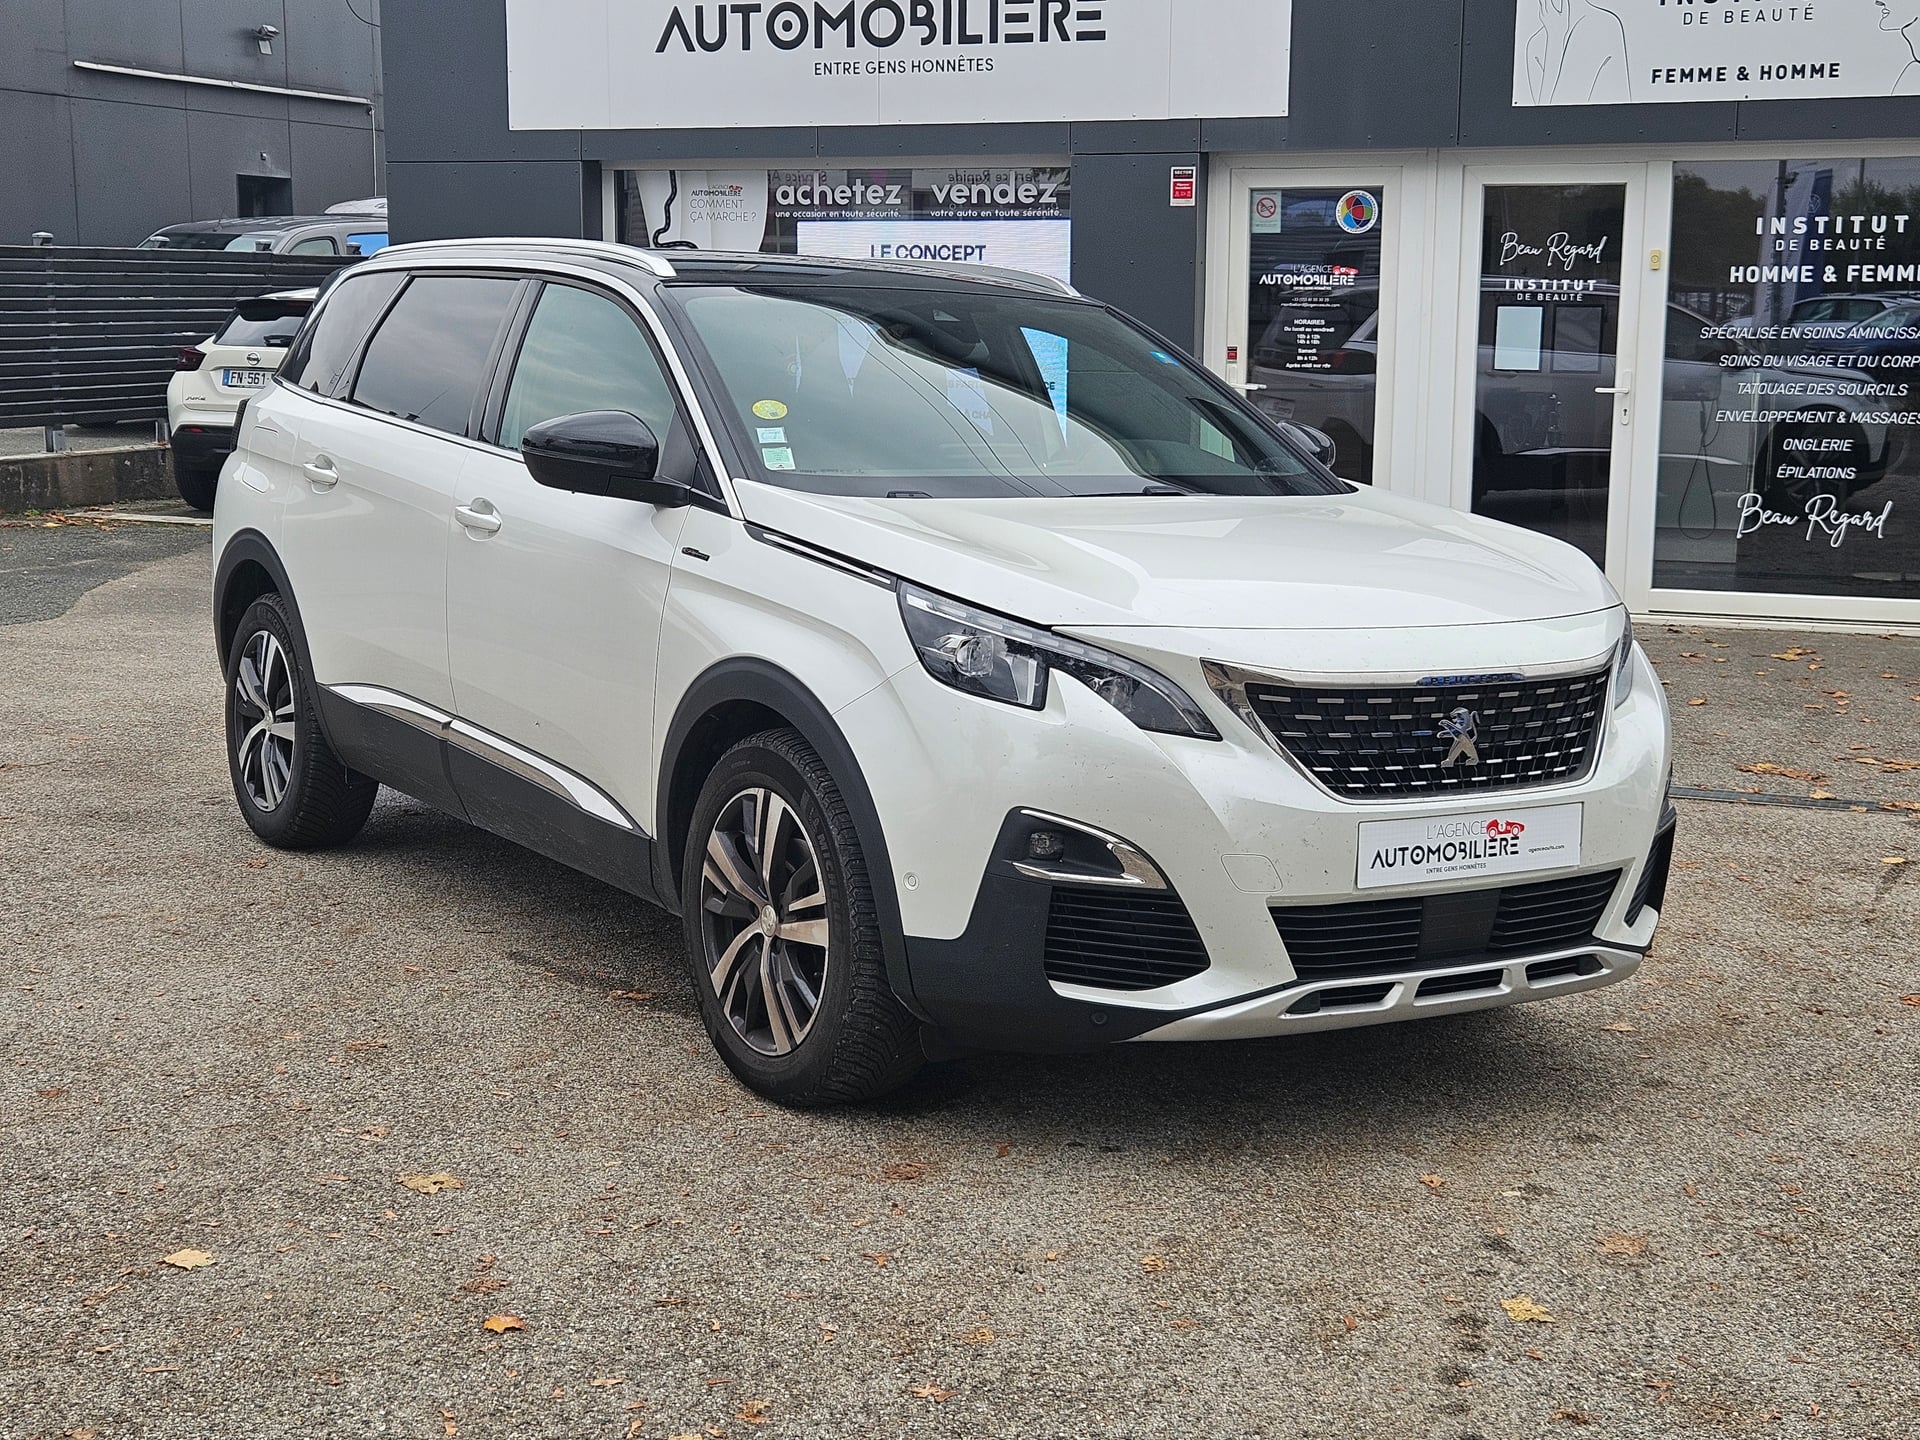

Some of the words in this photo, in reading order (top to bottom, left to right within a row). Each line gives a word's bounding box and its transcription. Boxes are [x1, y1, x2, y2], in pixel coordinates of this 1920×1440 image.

[1683, 12, 1709, 25] DE
[1724, 3, 1814, 24] BEAUTÉ
[813, 61, 861, 76] ENTRE
[865, 60, 906, 75] GENS
[910, 54, 994, 74] HONNÊTES
[1651, 66, 1727, 84] FEMME
[1736, 66, 1750, 81] &
[1759, 62, 1840, 81] HOMME
[775, 171, 902, 206] achetez
[931, 170, 1058, 205] vendez
[690, 199, 744, 209] COMMENT
[690, 211, 704, 223] ÇA
[706, 211, 748, 222] MARCHE
[751, 211, 757, 222] ?
[775, 210, 790, 218] une
[792, 209, 828, 218] occasion
[841, 208, 863, 217] toute
[866, 207, 902, 217] sécurité.
[930, 208, 954, 217] votre
[956, 208, 978, 217] auto
[981, 209, 992, 217] en
[995, 208, 1019, 217] toute
[1022, 207, 1063, 217] sérénité.
[1756, 214, 1910, 235] INSTITUT
[1775, 239, 1798, 251] DE
[1810, 235, 1887, 251] BEAUTÉ
[895, 244, 987, 261] CONCEPT
[1500, 231, 1543, 266] Beau
[1547, 231, 1608, 271] Regard
[1293, 264, 1333, 273] L'AGENCE
[1729, 265, 1815, 283] HOMME
[1822, 265, 1839, 283] &
[1847, 264, 1920, 283] FEMM
[1505, 279, 1597, 291] INSTITUT
[1517, 293, 1532, 301] DE
[1537, 291, 1583, 301] BEAUTÉ
[1700, 325, 1780, 340] SPÉCIALISÉ
[1780, 327, 1800, 339] EN
[1802, 327, 1846, 339] SOINS
[1719, 355, 1761, 368] SOINS
[1763, 355, 1784, 368] DU
[1786, 355, 1835, 368] VISAGE
[1837, 355, 1857, 367] ET
[1857, 355, 1880, 368] DU
[1881, 355, 1920, 368] CORP
[230, 371, 275, 385] FN-561-
[1737, 383, 1804, 396] TATOUAGE
[1806, 384, 1835, 396] DES
[1836, 384, 1909, 397] SOURCILS
[1715, 411, 1836, 424] ENVELOPPEMENT
[1836, 412, 1847, 424] &
[1783, 438, 1854, 452] ONGLERIE
[1776, 464, 1857, 480] ÉPILATIONS
[1736, 492, 1799, 539] Beau
[1804, 494, 1894, 548] Regard
[1426, 819, 1487, 840] L'AGENCE
[1426, 865, 1443, 874] ENTRE
[1444, 864, 1458, 873] GENS
